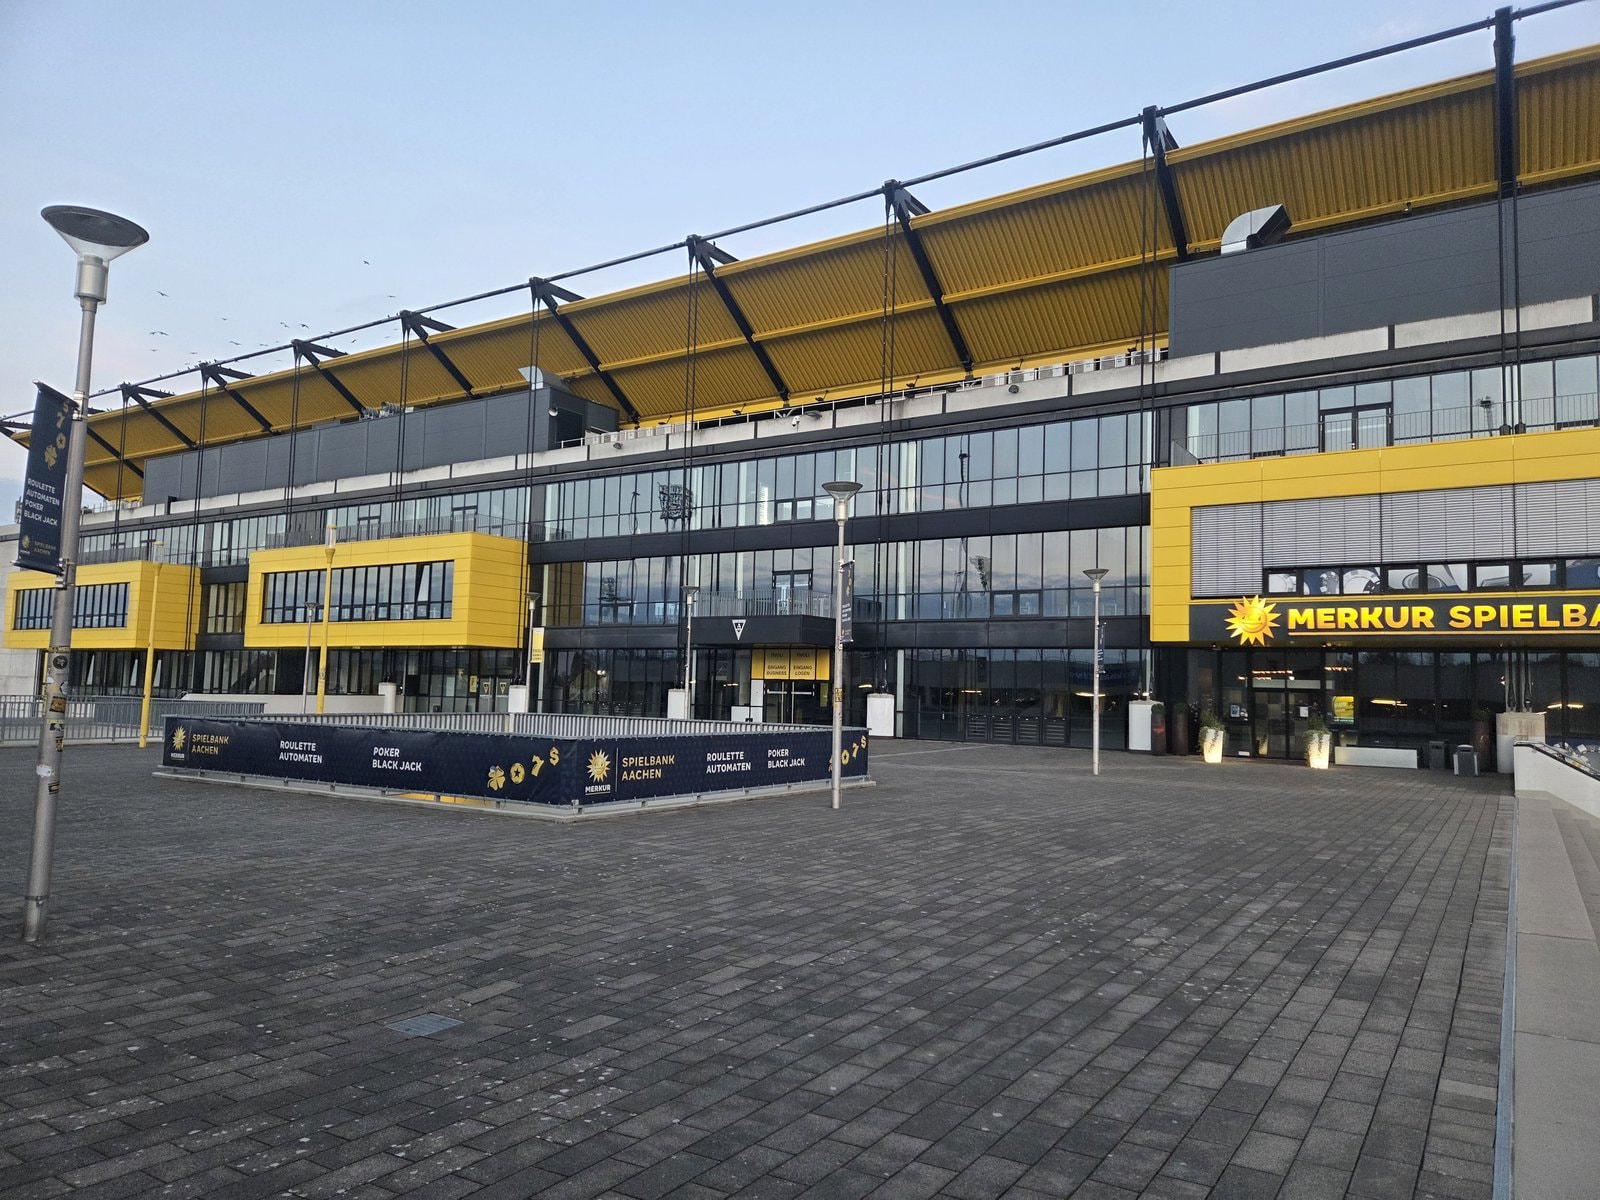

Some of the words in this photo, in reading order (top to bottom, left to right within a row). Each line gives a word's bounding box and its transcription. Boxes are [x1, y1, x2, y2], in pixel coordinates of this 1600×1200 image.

[28, 478, 56, 494] ROULETTE
[26, 489, 60, 506] AUTOMATEN
[25, 499, 44, 511] POKER
[24, 510, 42, 521] BLACK
[43, 516, 58, 526] JACK
[1288, 606, 1435, 630] MERKUR
[191, 733, 229, 744] SPIELBANK
[191, 746, 219, 755] AACHEN
[279, 740, 316, 752] ROULETTE
[373, 746, 400, 758] POKER
[279, 752, 323, 764] AUTOMATEN
[706, 751, 744, 762] ROULETTE
[768, 749, 789, 758] POKER
[372, 759, 399, 770] BLACK
[399, 761, 422, 772] JACK
[622, 755, 675, 768] SPIELBANK
[768, 759, 788, 769] BLACK
[789, 758, 805, 768] JACK
[706, 762, 751, 774] AUTOMATEN
[621, 768, 662, 781] AACHEN
[585, 784, 611, 793] MERKUR
